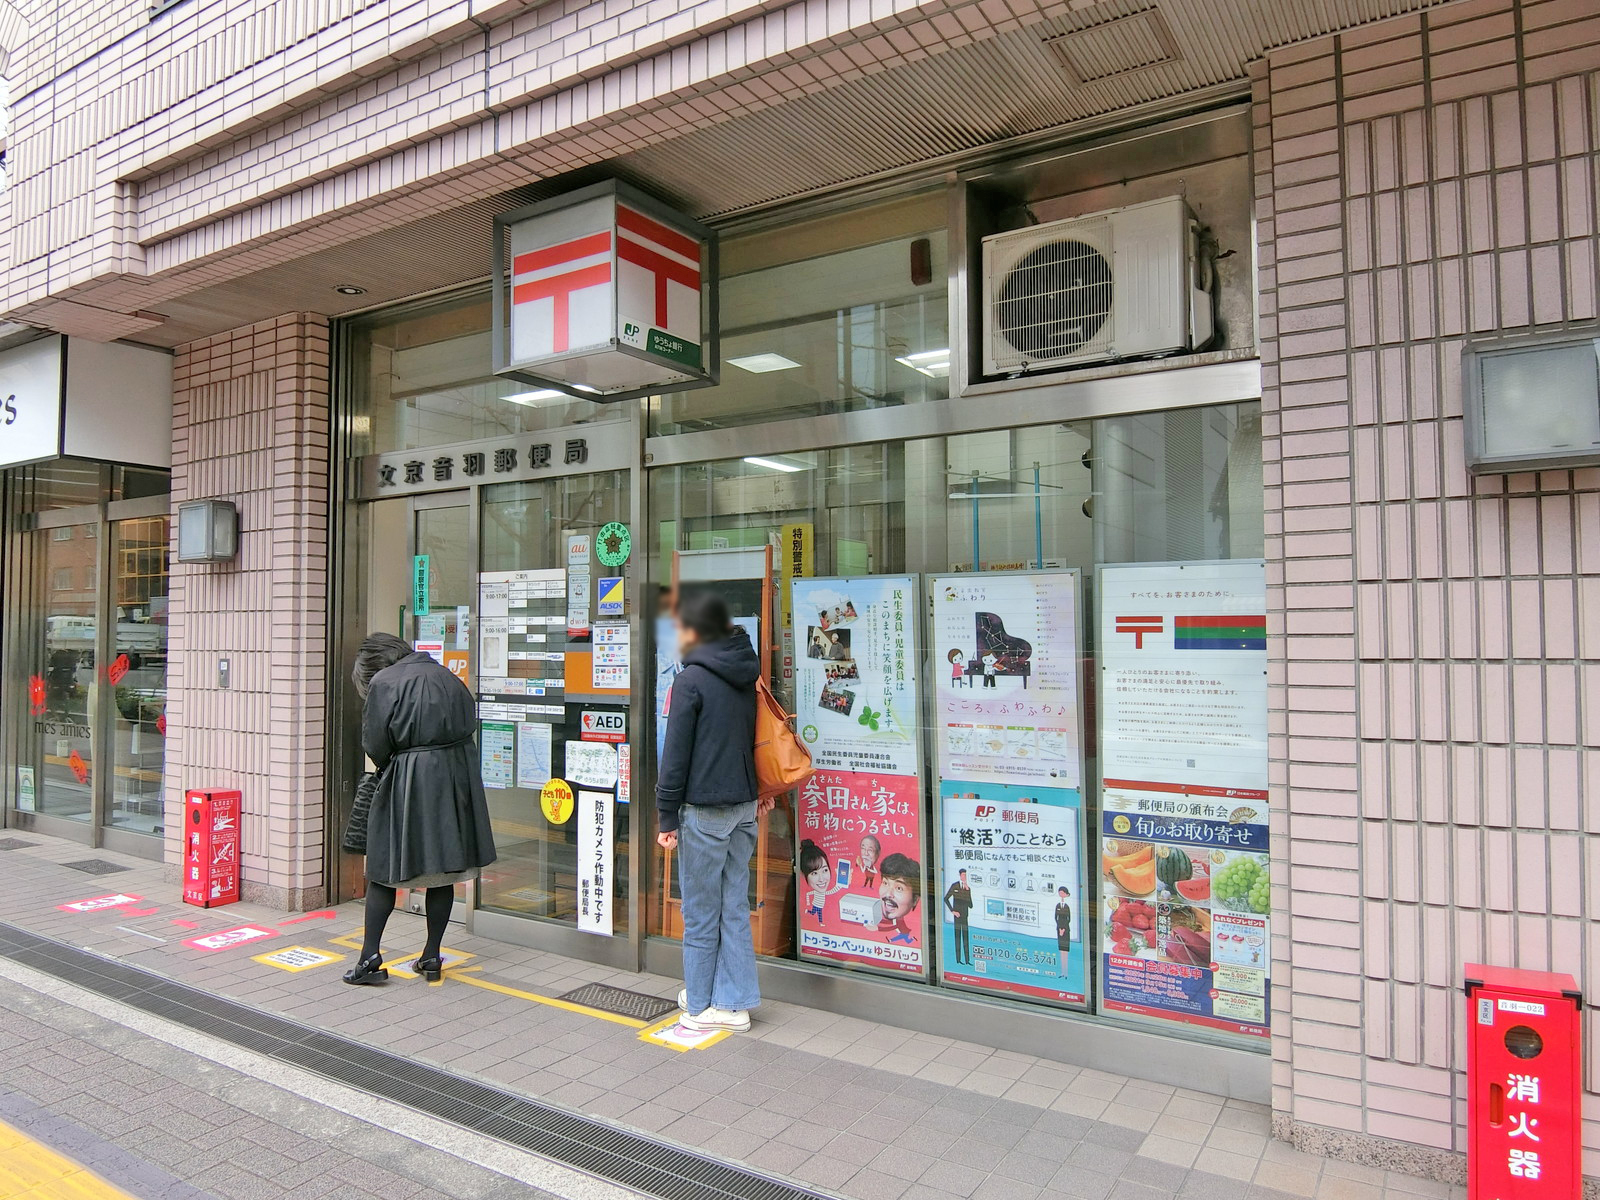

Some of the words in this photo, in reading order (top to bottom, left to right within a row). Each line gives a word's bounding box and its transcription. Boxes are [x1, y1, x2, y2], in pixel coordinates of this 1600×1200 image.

[653, 335, 684, 353] ゆうちょ銀行
[0, 394, 17, 425] s
[377, 438, 589, 488] 文京音羽郵便局
[572, 544, 587, 553] au
[792, 528, 803, 577] 特別警戒
[1130, 591, 1235, 599] すべてを、お客さまのために。
[893, 589, 904, 691] 民生委員・児童委員は
[881, 600, 894, 734] このまちに笑顔を広げます。
[1116, 669, 1200, 677] 一人ひとりのお客さまに寄り添い、
[34, 720, 57, 736] mes
[60, 723, 91, 740] amies
[595, 715, 623, 729] AED
[821, 750, 891, 760] 全国民生委員児童委員連合会
[620, 780, 629, 796] 禁止
[1001, 809, 1039, 825] 郵便局
[1137, 798, 1229, 819] 郵便局の頒布会
[804, 810, 913, 838] 荷物にうるさい。
[1134, 818, 1253, 845] 旬のお取り寄せ
[191, 832, 200, 881] 消火器
[594, 799, 605, 924] 防犯カメラ作動中です
[954, 849, 1070, 863] 郵便局になんでもご相談ください
[186, 890, 203, 901] 文京区
[581, 879, 589, 916] 郵便局長
[1006, 906, 1036, 915] 郵便局にて
[1006, 912, 1037, 922] 無料配布中
[1214, 915, 1264, 927] もれなくプレゼント
[987, 947, 1056, 966] 0120-65-3741
[1145, 961, 1203, 980] 会員募集中
[1506, 1073, 1541, 1179] 消火器
